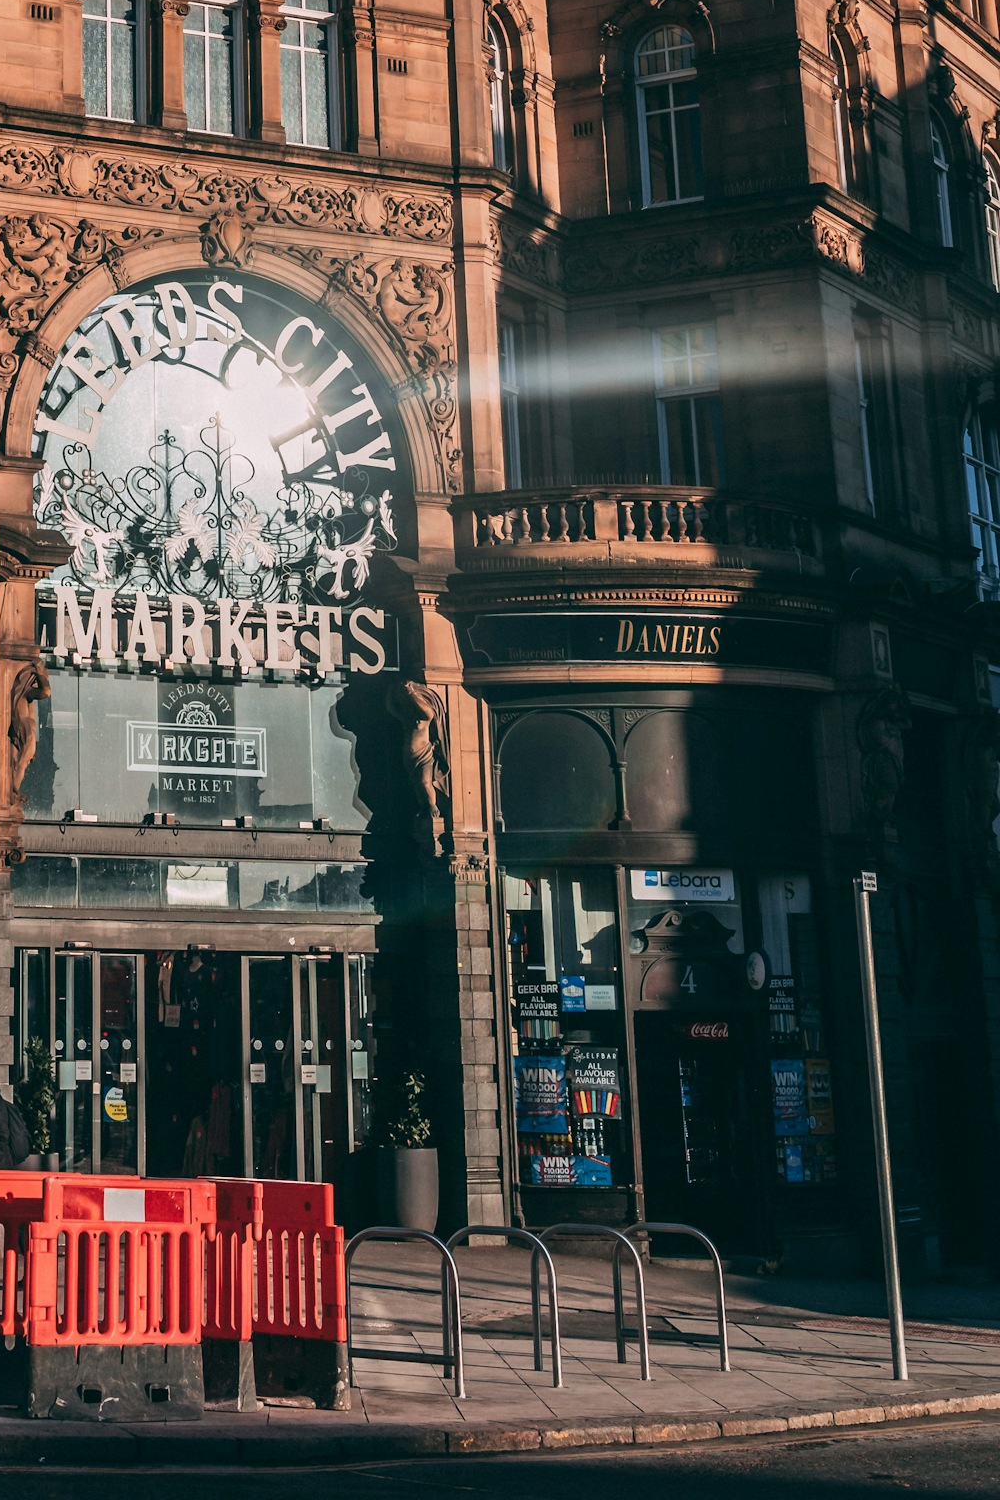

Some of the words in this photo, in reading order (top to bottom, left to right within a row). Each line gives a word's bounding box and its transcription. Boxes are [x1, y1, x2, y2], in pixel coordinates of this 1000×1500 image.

[36, 281, 243, 446] LEEDS
[275, 316, 396, 473] CITY
[53, 585, 385, 675] MARKETS
[615, 619, 721, 655] DANIELS
[508, 647, 565, 660] Tobacconist
[162, 683, 204, 710] LEEDS
[206, 684, 232, 714] CITY
[137, 733, 257, 765] KIRKGATE
[163, 778, 233, 793] MARKET
[660, 872, 721, 888] Lebara
[692, 888, 722, 897] mobile
[784, 881, 795, 900] S
[680, 965, 697, 994] 4
[518, 985, 541, 995] GEEK
[541, 984, 558, 994] BAR
[520, 1002, 558, 1010] FLAVOURS
[531, 995, 546, 1003] ALL
[588, 1062, 602, 1070] ALL
[522, 1067, 558, 1083] WIN
[575, 1070, 616, 1078] FLAVOURS
[576, 1076, 616, 1085] AVAILABLE
[774, 1071, 798, 1087] WIN
[543, 1156, 570, 1168] WIN
